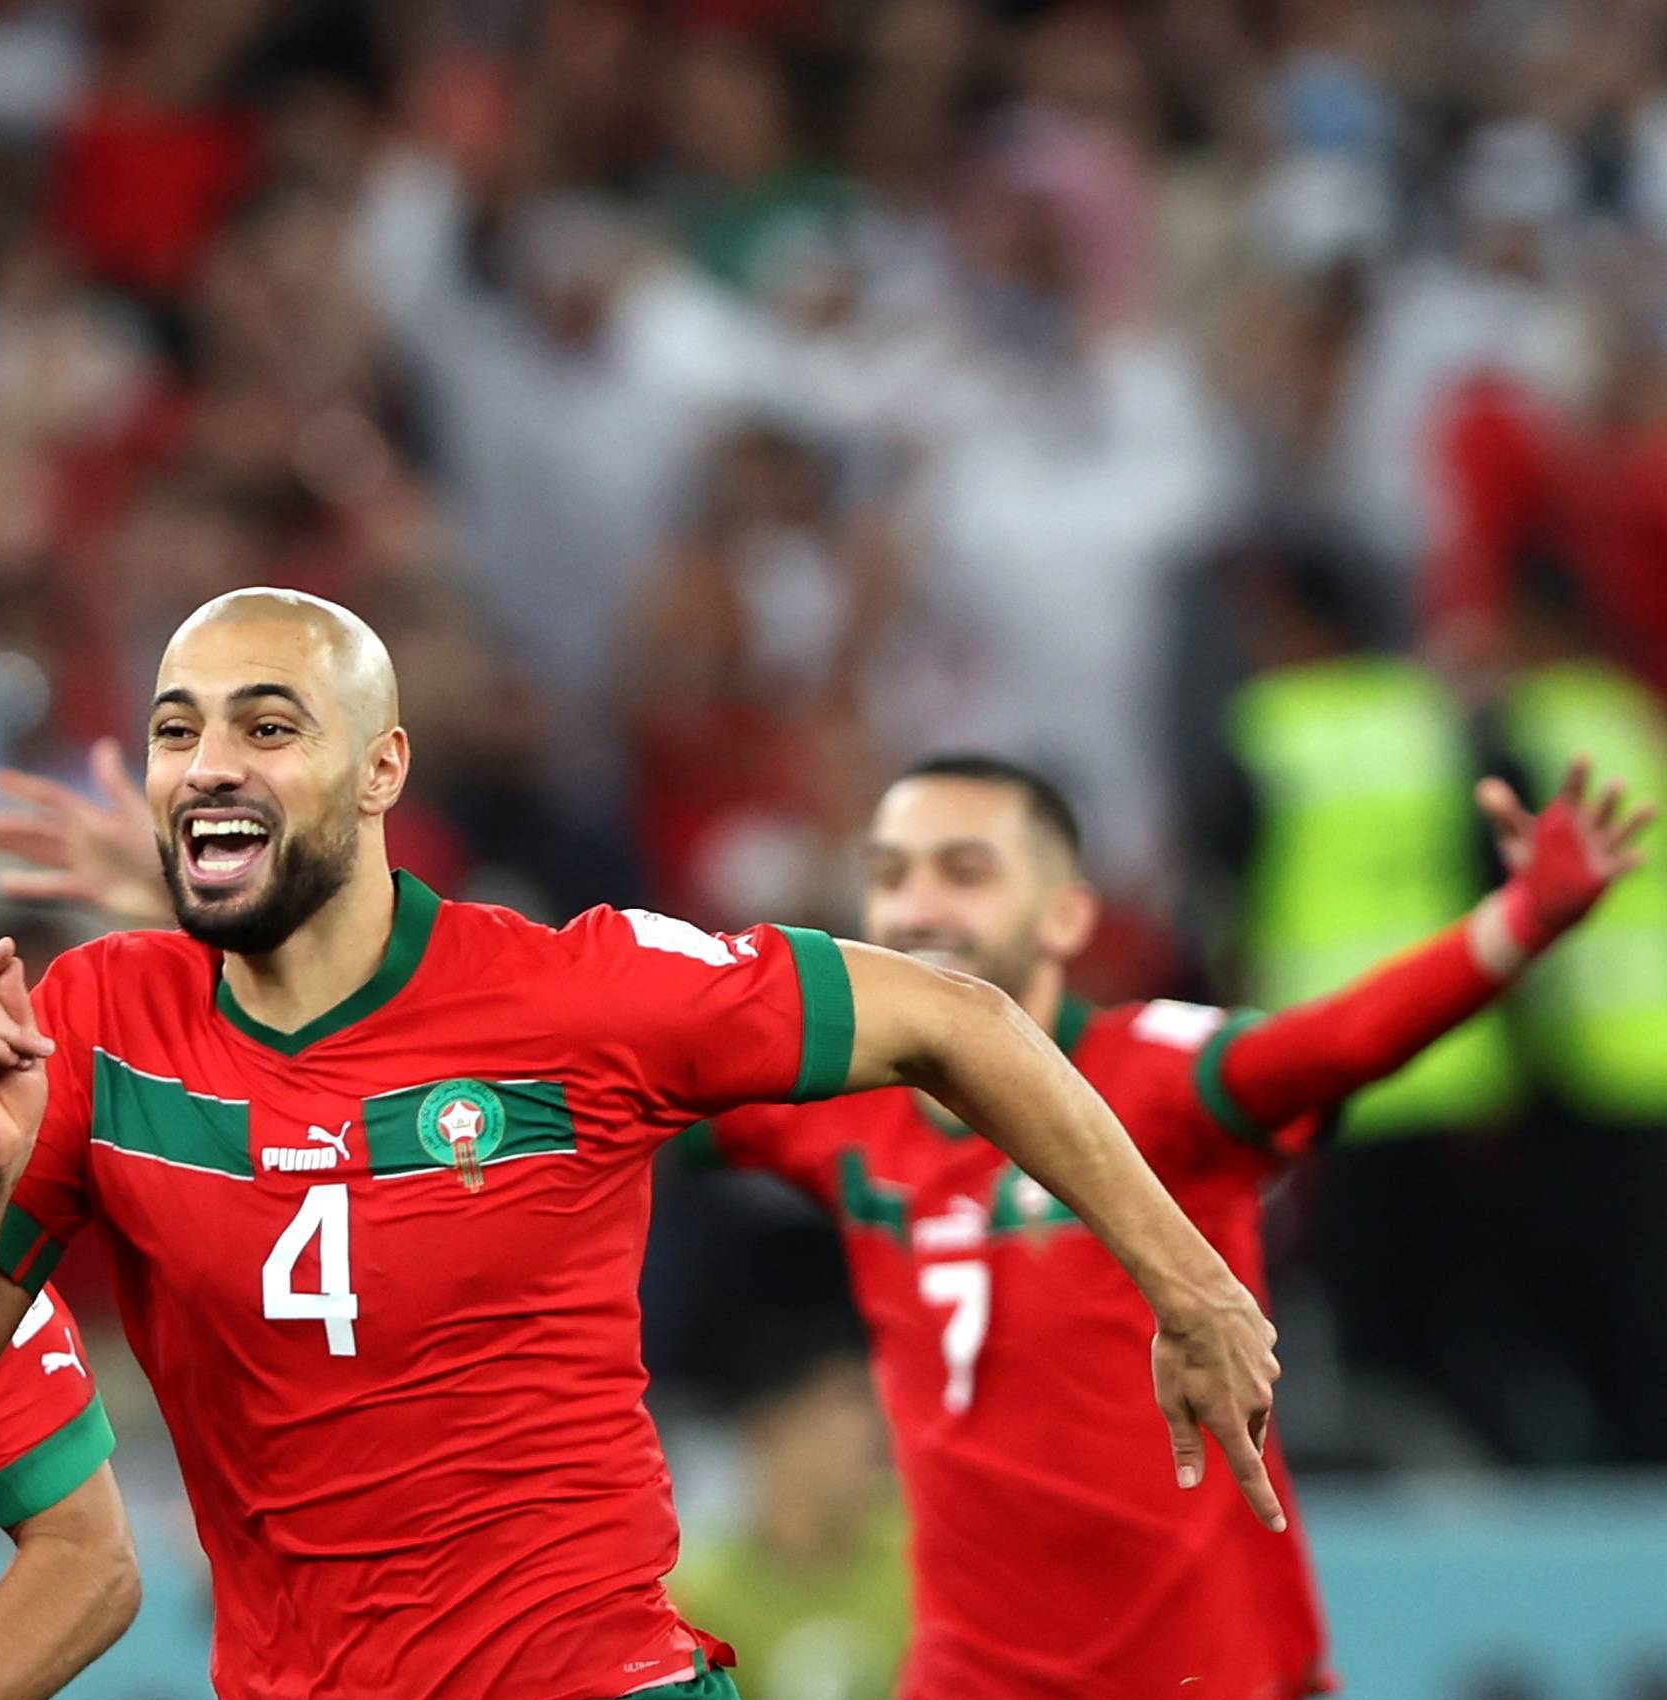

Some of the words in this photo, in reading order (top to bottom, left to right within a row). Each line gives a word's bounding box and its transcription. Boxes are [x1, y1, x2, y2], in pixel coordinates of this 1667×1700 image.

[262, 1146, 337, 1173] PUMA
[263, 1183, 358, 1356] 4
[919, 1262, 989, 1412] 7
